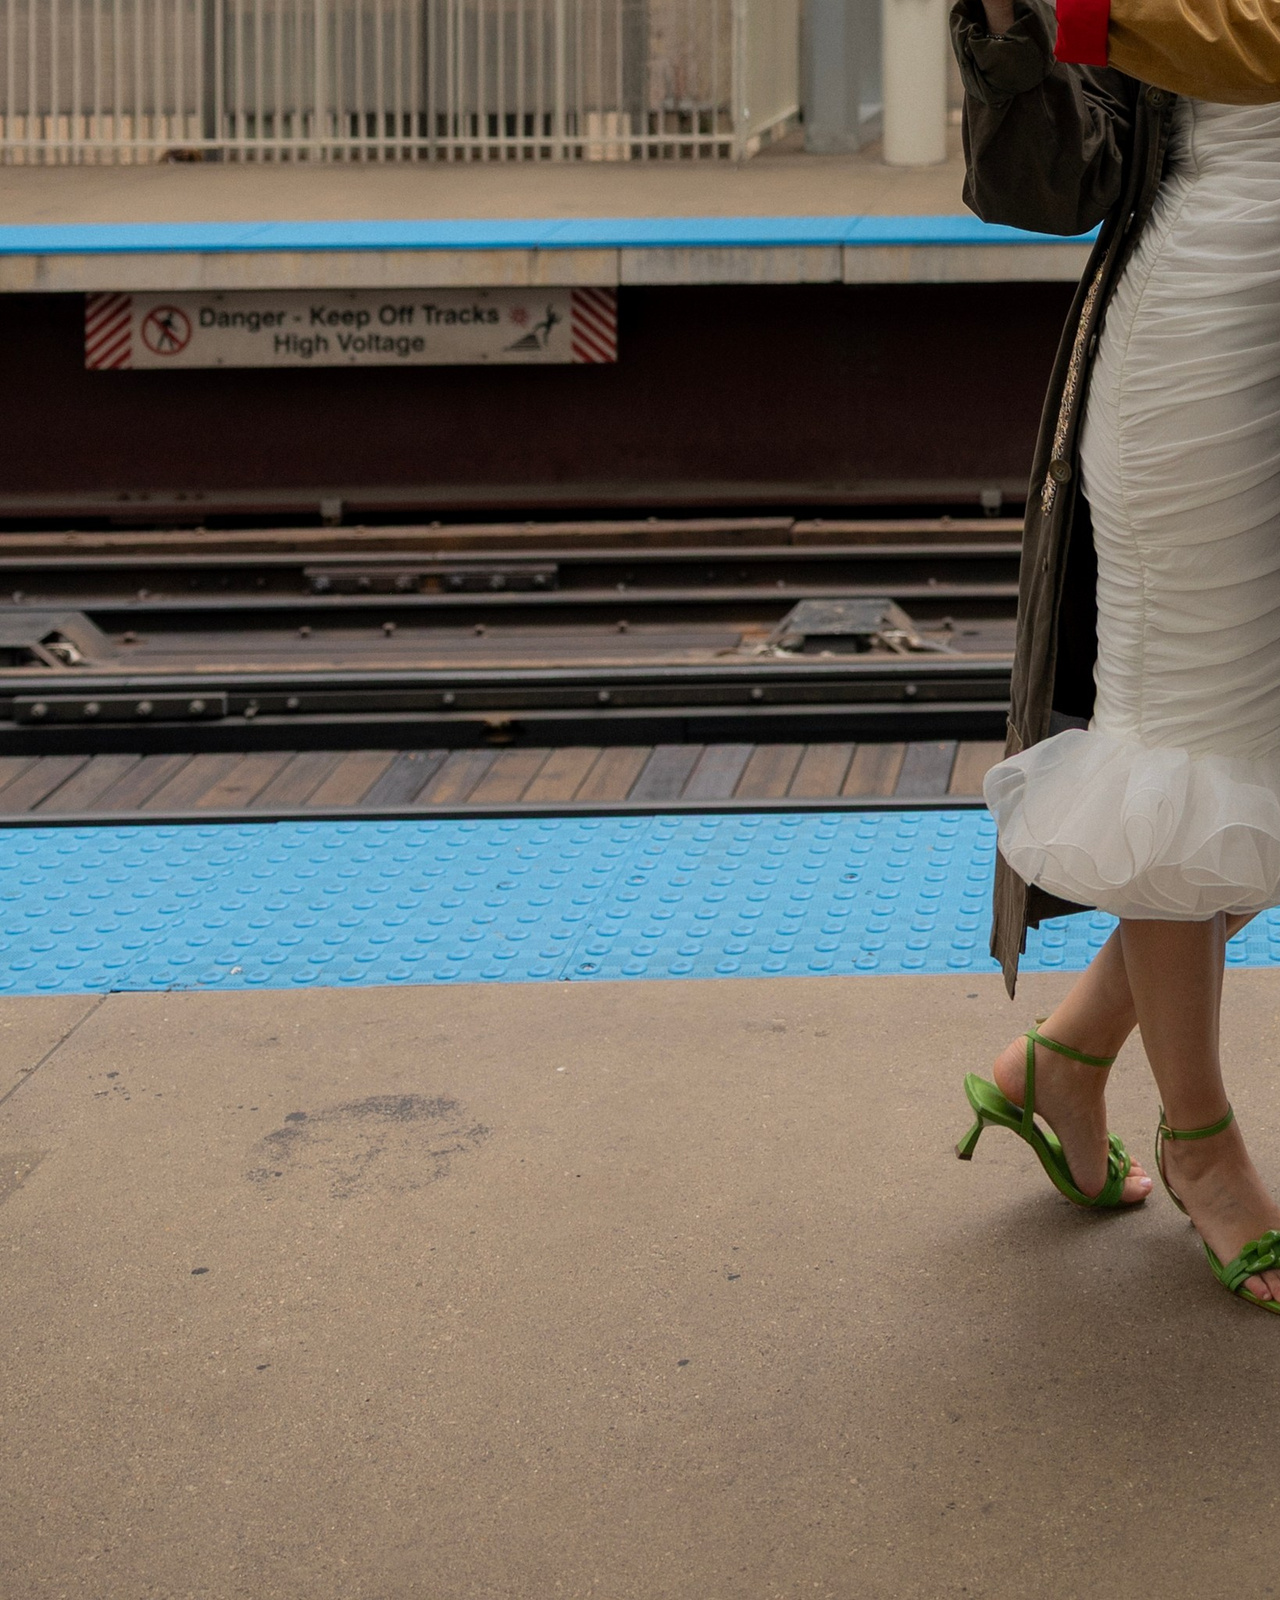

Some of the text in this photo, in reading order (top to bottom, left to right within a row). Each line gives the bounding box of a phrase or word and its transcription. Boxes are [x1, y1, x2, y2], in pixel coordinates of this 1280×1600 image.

[199, 307, 286, 331] Danger
[308, 305, 371, 328] Keep
[378, 304, 415, 325] Off
[422, 304, 500, 325] Tracks
[273, 332, 425, 359] High Voltage
